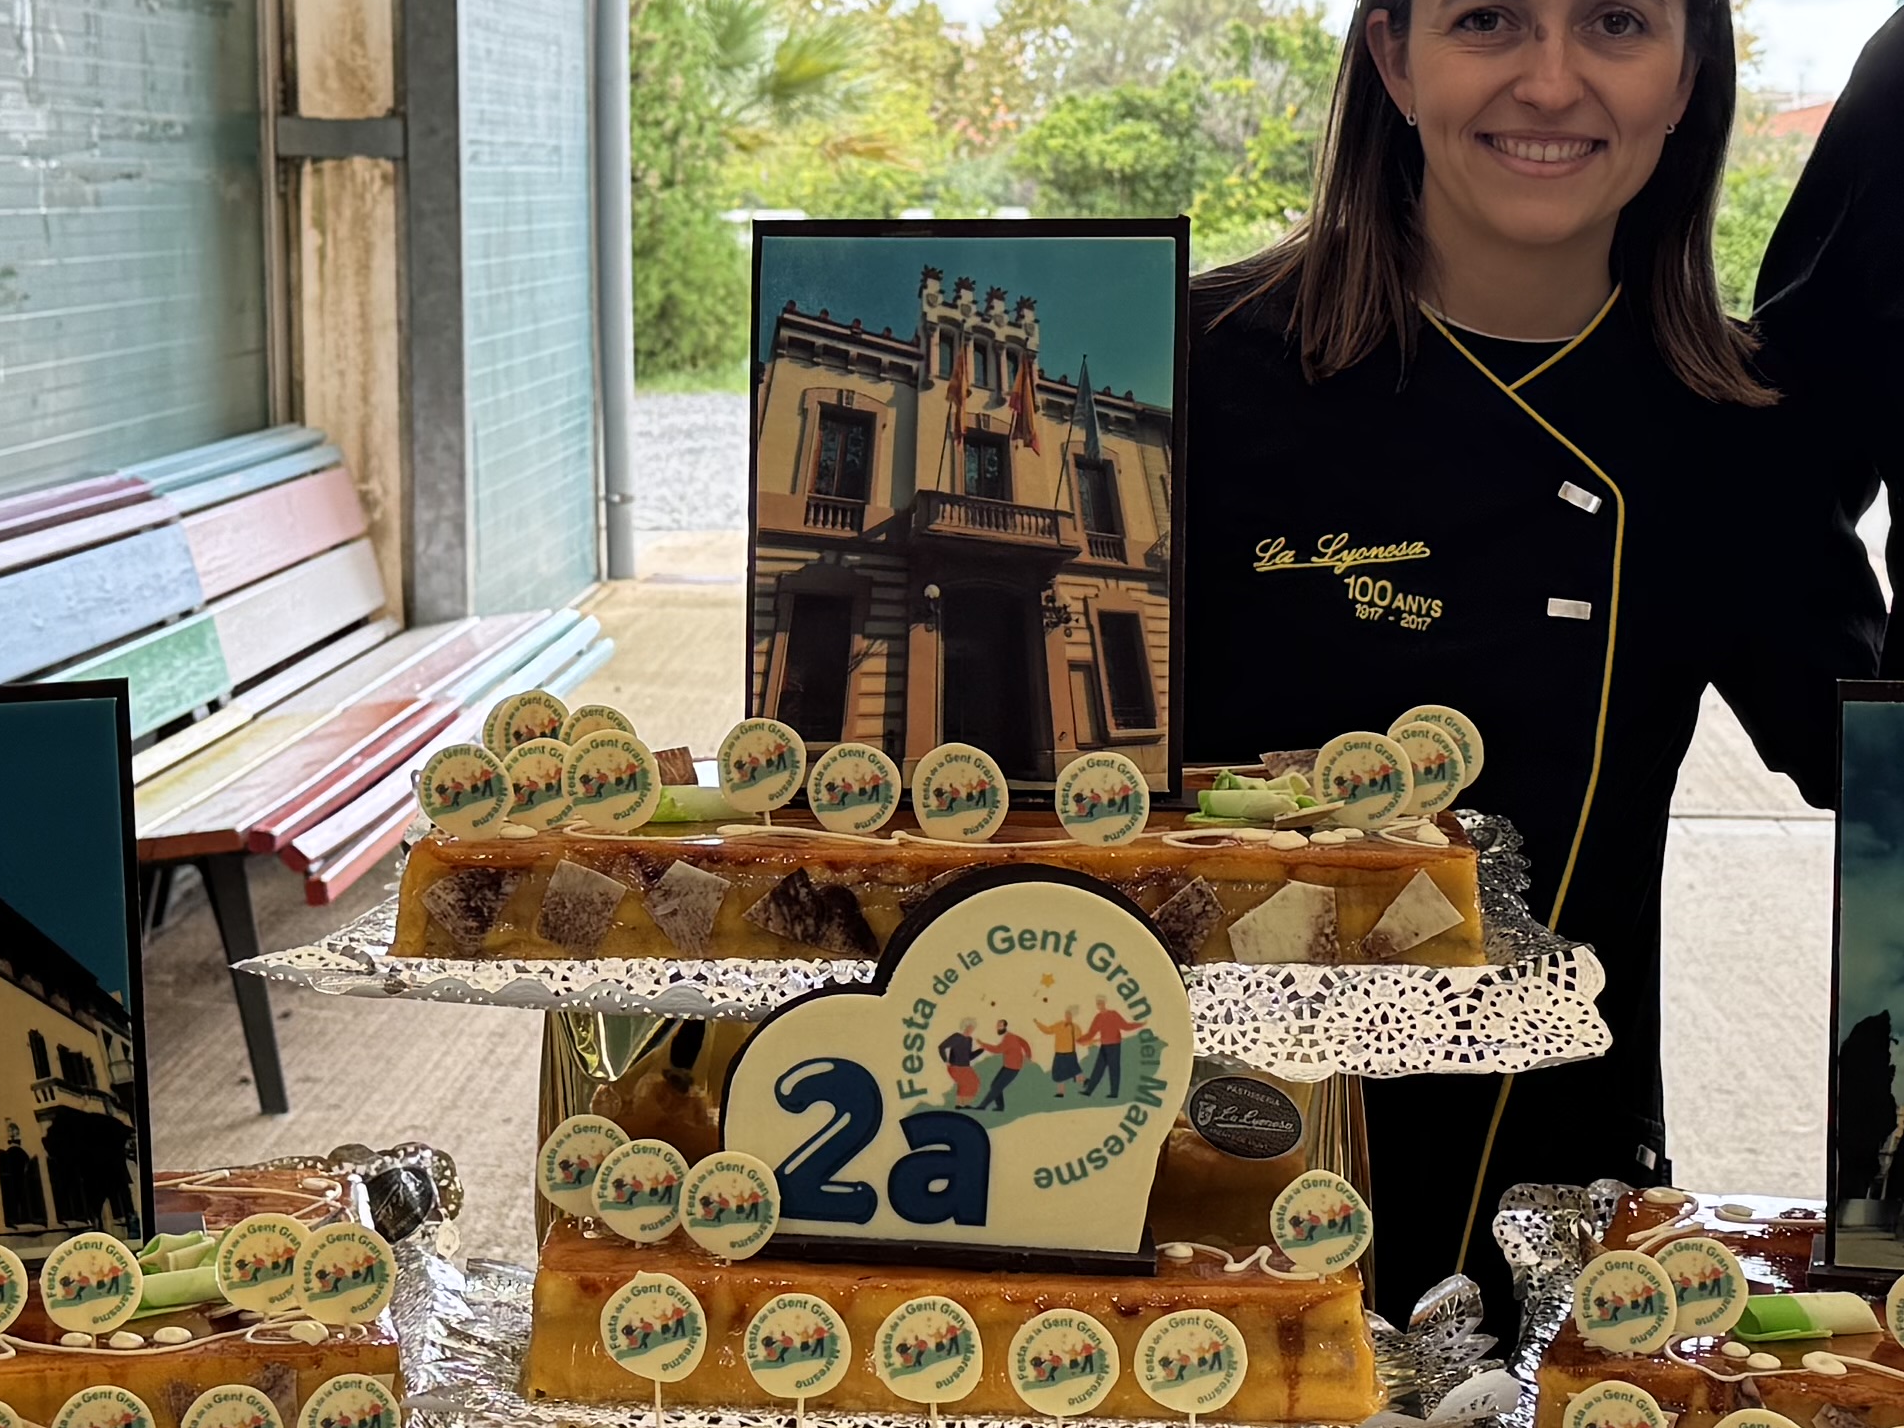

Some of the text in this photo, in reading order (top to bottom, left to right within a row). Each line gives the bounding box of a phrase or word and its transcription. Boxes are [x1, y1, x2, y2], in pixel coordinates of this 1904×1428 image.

[1253, 532, 1430, 574] La Lyonesa
[1355, 603, 1383, 620] 1917
[1400, 613, 1431, 631] 2017
[590, 739, 618, 749] Gent
[621, 742, 644, 765] Gran
[898, 924, 1167, 1190] Festa de la Gent Gran del Maresme
[774, 1057, 991, 1227] 2a
[715, 1162, 745, 1174] Gent
[747, 1169, 768, 1196] Gran
[1301, 1179, 1359, 1206] Gent Gran
[326, 1232, 355, 1244] Gent
[358, 1235, 381, 1257] Gran
[906, 1301, 936, 1315] Gent
[940, 1303, 965, 1326] Gran
[1042, 1318, 1073, 1329] Gent
[1076, 1321, 1101, 1346] Gran
[1169, 1316, 1200, 1328] Gent
[1203, 1318, 1229, 1342] Gran
[82, 1390, 112, 1403] Gent
[115, 1392, 140, 1414] Gran
